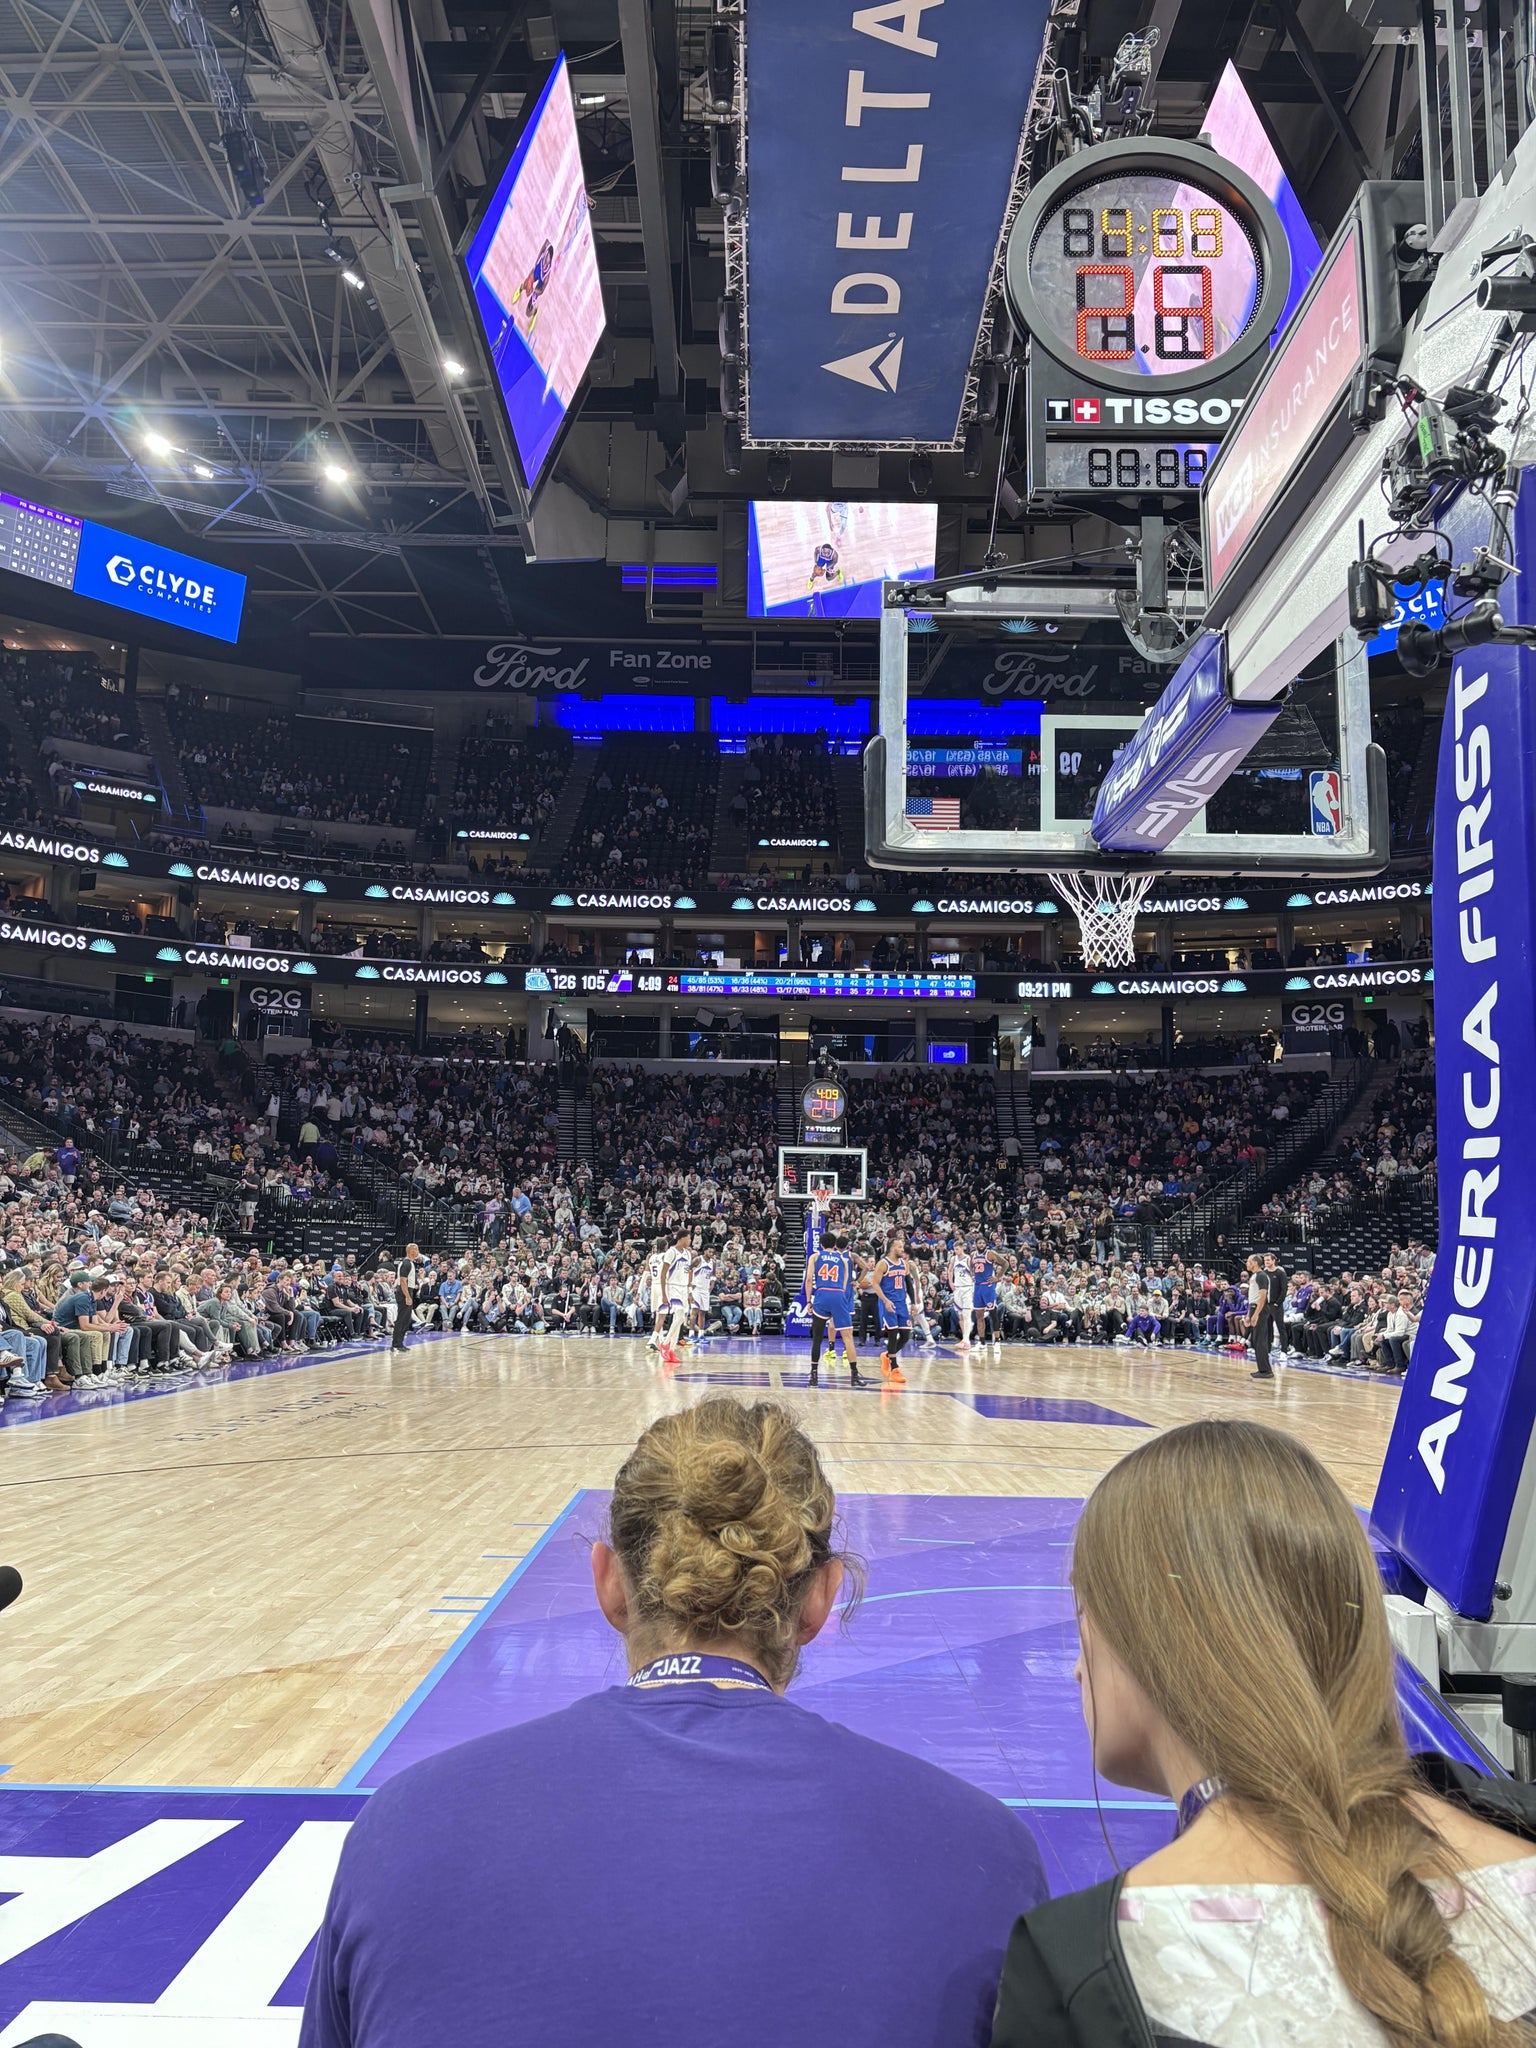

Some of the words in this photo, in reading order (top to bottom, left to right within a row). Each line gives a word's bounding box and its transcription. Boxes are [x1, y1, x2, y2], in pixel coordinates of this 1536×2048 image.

[830, 0, 945, 314] DELTA
[1076, 265, 1213, 359] 24
[1252, 293, 1353, 473] INSURANCE
[137, 584, 212, 614] COMPANIES
[473, 643, 591, 690] Ford
[610, 650, 651, 668] Fan
[656, 651, 712, 669] Zone
[982, 651, 1099, 697] Ford
[87, 782, 143, 800] CASAMIGOS
[1454, 665, 1497, 964] FIRST
[469, 830, 518, 840] CASAMIGOS
[1316, 821, 1331, 833] NBA
[0, 830, 100, 864] ASAMIGOS
[770, 838, 817, 848] CASAMIGOS
[196, 865, 300, 891] CASAMIGOS
[391, 886, 490, 905] CASAMIGOS
[576, 893, 672, 909] CASAMIGOS
[1314, 882, 1422, 905] CASAMIGOS
[757, 897, 852, 912] CASAMIGOS
[937, 900, 1034, 914] CASAMIGOS
[184, 949, 290, 974] CASAMIGOS
[382, 966, 482, 985] CASAMIGOS
[553, 975, 577, 990] 126
[581, 975, 606, 990] 105
[637, 976, 662, 991] 4:09
[669, 976, 678, 984] 24
[1313, 968, 1422, 989] CASAMIGOS
[666, 984, 678, 992] 4TH
[1018, 981, 1049, 998] 09:21
[1052, 982, 1071, 998] PM
[1117, 979, 1219, 995] CASAMIGOS
[249, 986, 302, 1009] G2G
[1291, 1003, 1345, 1024] G2G
[1295, 1024, 1328, 1032] PROTEIN
[816, 1088, 839, 1100] 4:09
[811, 1099, 837, 1119] 24
[814, 1125, 842, 1133] TISSOT
[1417, 980, 1502, 1495] AMERICA
[652, 1265, 658, 1277] 5
[818, 1263, 840, 1283] 44
[656, 1656, 702, 1676] JAZZ
